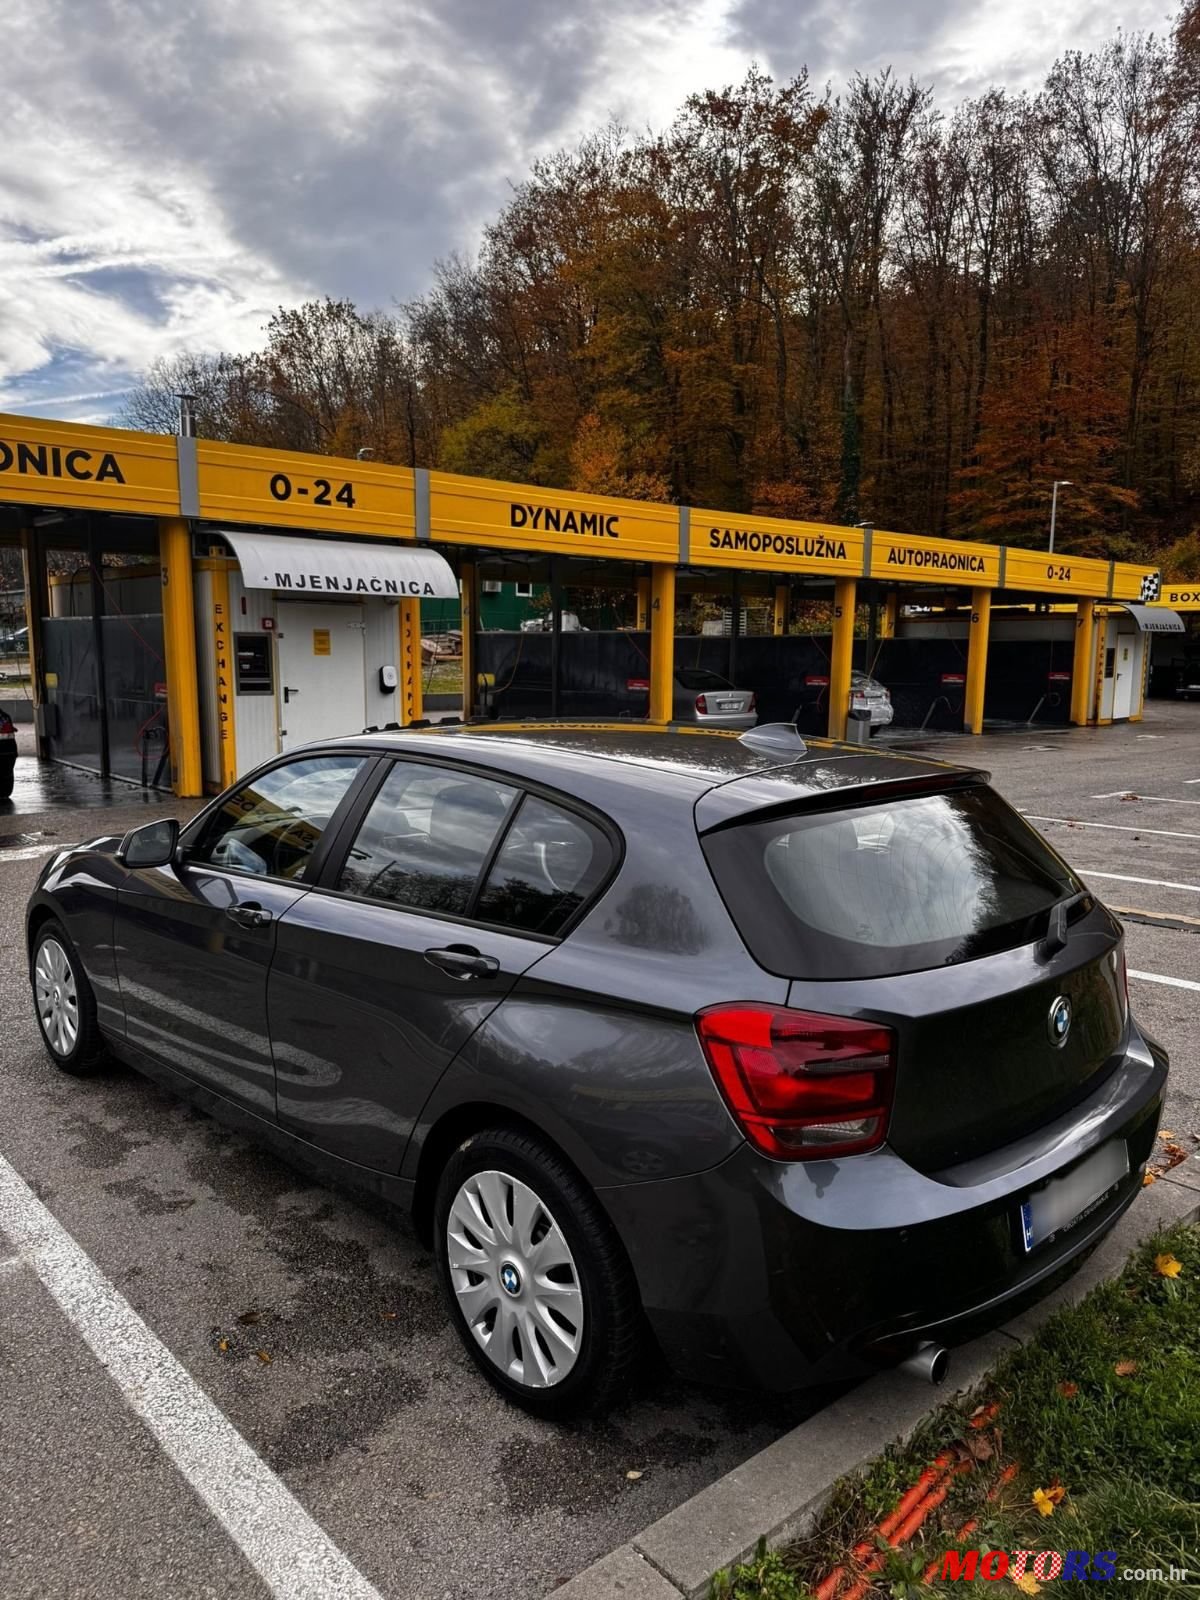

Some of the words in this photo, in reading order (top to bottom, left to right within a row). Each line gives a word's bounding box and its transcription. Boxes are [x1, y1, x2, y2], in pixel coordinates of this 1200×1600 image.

[270, 473, 356, 508] 0-24
[511, 503, 619, 538] DYNAMIC
[710, 528, 847, 559] SAMOPOSLUŽNA
[888, 548, 985, 572] AUTOPRAONICA
[274, 572, 435, 596] MJENJAČNICA
[1047, 565, 1071, 581] 0-24
[652, 598, 660, 611] 4
[835, 606, 843, 618] 5
[971, 613, 980, 623] 6
[215, 604, 228, 740] EXCHANGE
